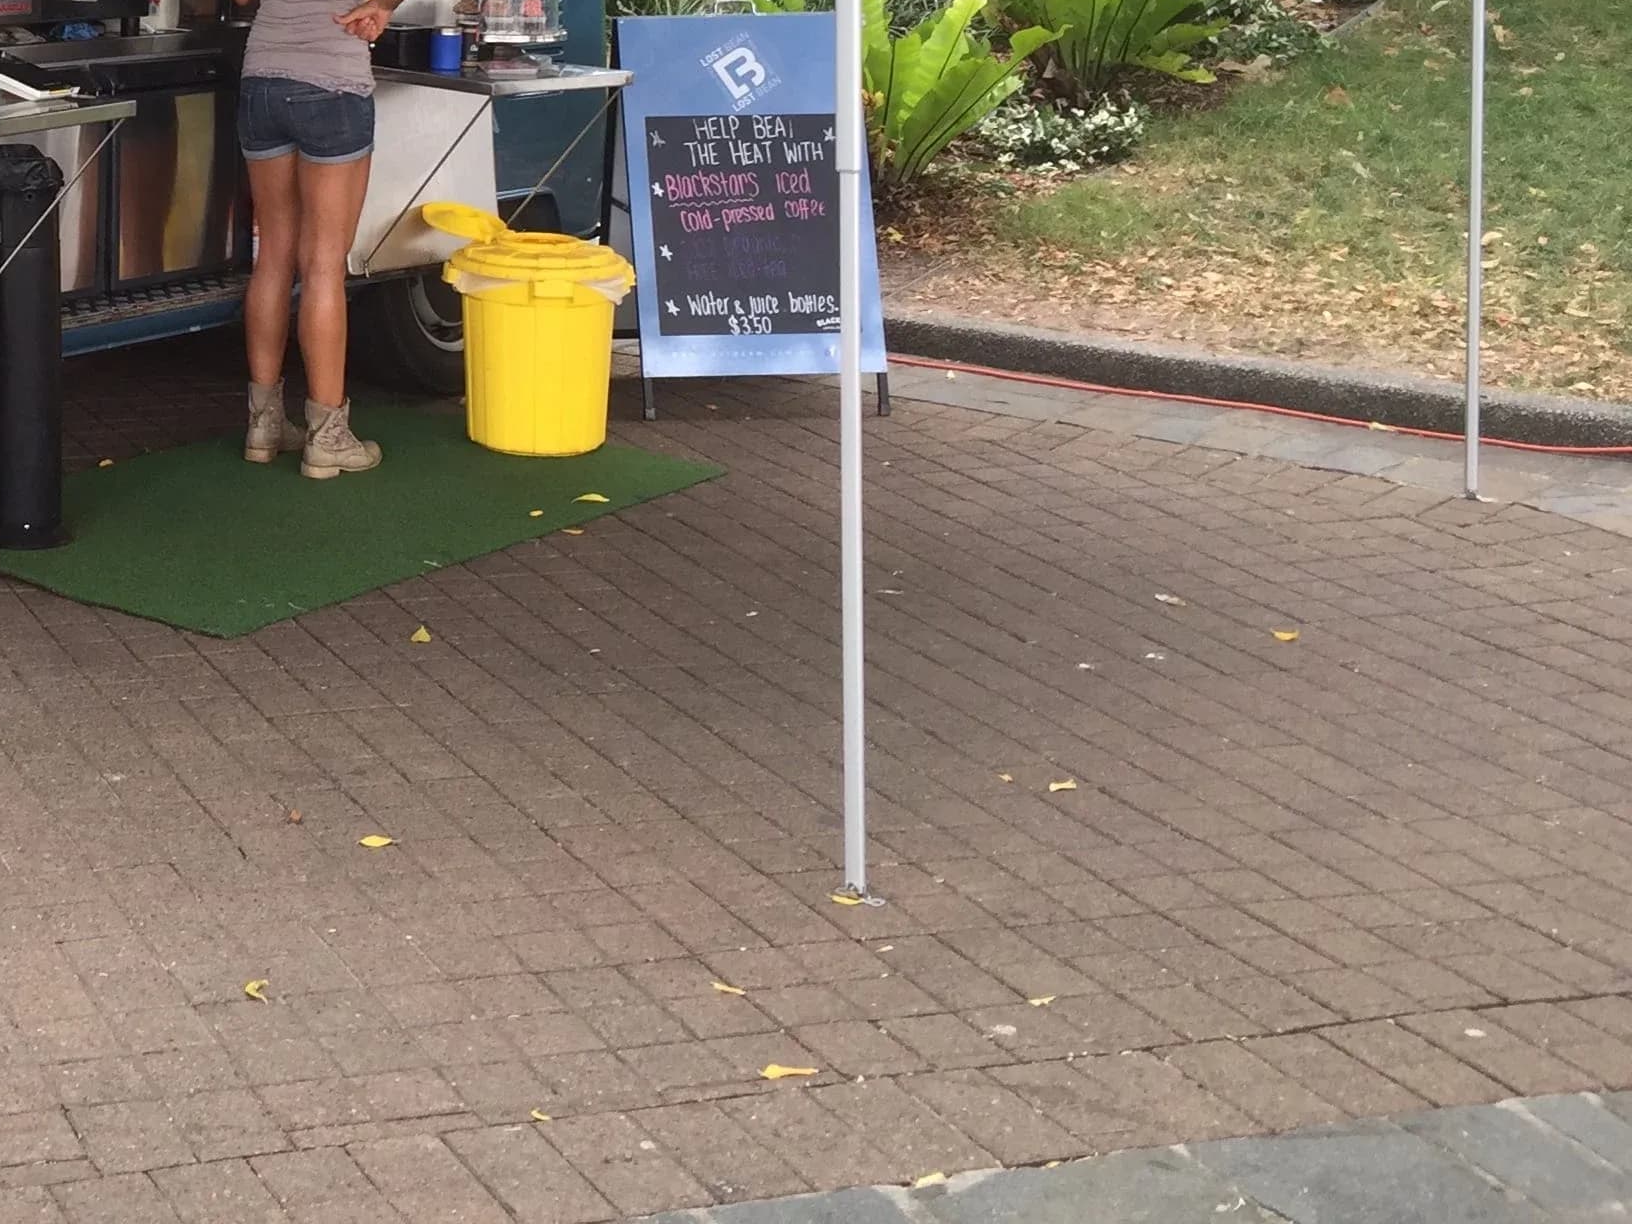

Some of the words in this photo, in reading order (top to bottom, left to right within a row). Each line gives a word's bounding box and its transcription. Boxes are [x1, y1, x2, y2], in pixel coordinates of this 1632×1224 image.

[699, 47, 722, 67] LOST
[731, 92, 756, 112] LOST
[693, 115, 740, 140] HELP
[683, 141, 720, 168] THE
[729, 140, 773, 166] HEAT
[783, 141, 824, 164] WITH
[665, 170, 760, 202] Blackstars
[734, 299, 745, 315] &
[728, 314, 772, 336] $3.50
